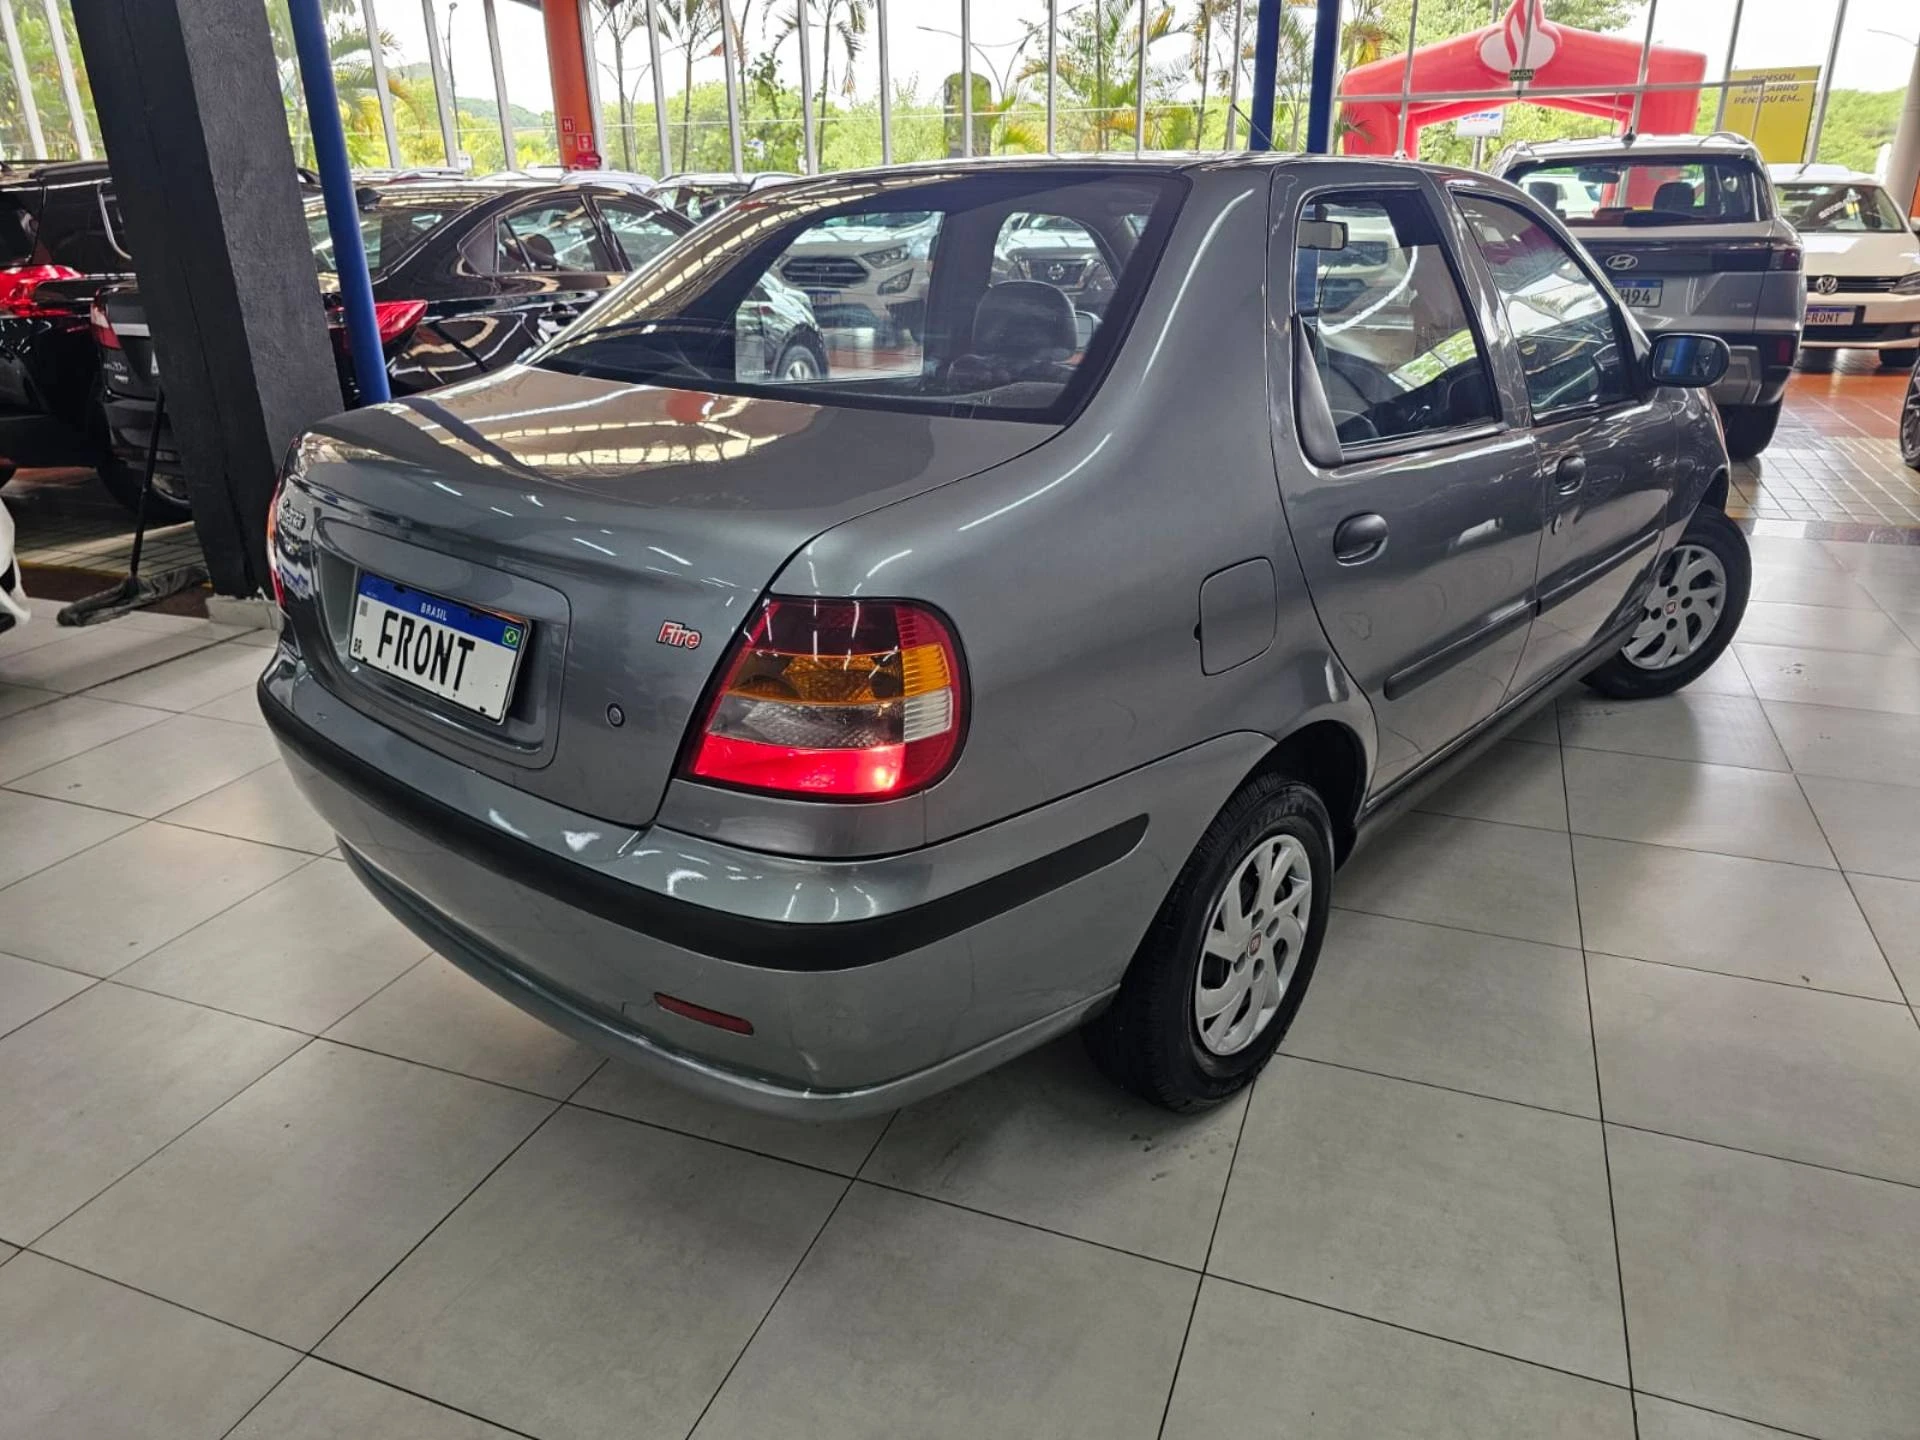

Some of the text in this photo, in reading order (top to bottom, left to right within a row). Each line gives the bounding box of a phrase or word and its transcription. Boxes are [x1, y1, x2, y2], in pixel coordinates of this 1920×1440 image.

[1734, 95, 1778, 104] PENOU
[420, 602, 447, 621] BRASIL
[656, 620, 702, 649] Fire
[353, 637, 362, 654] BR
[377, 609, 475, 692] FRONT
